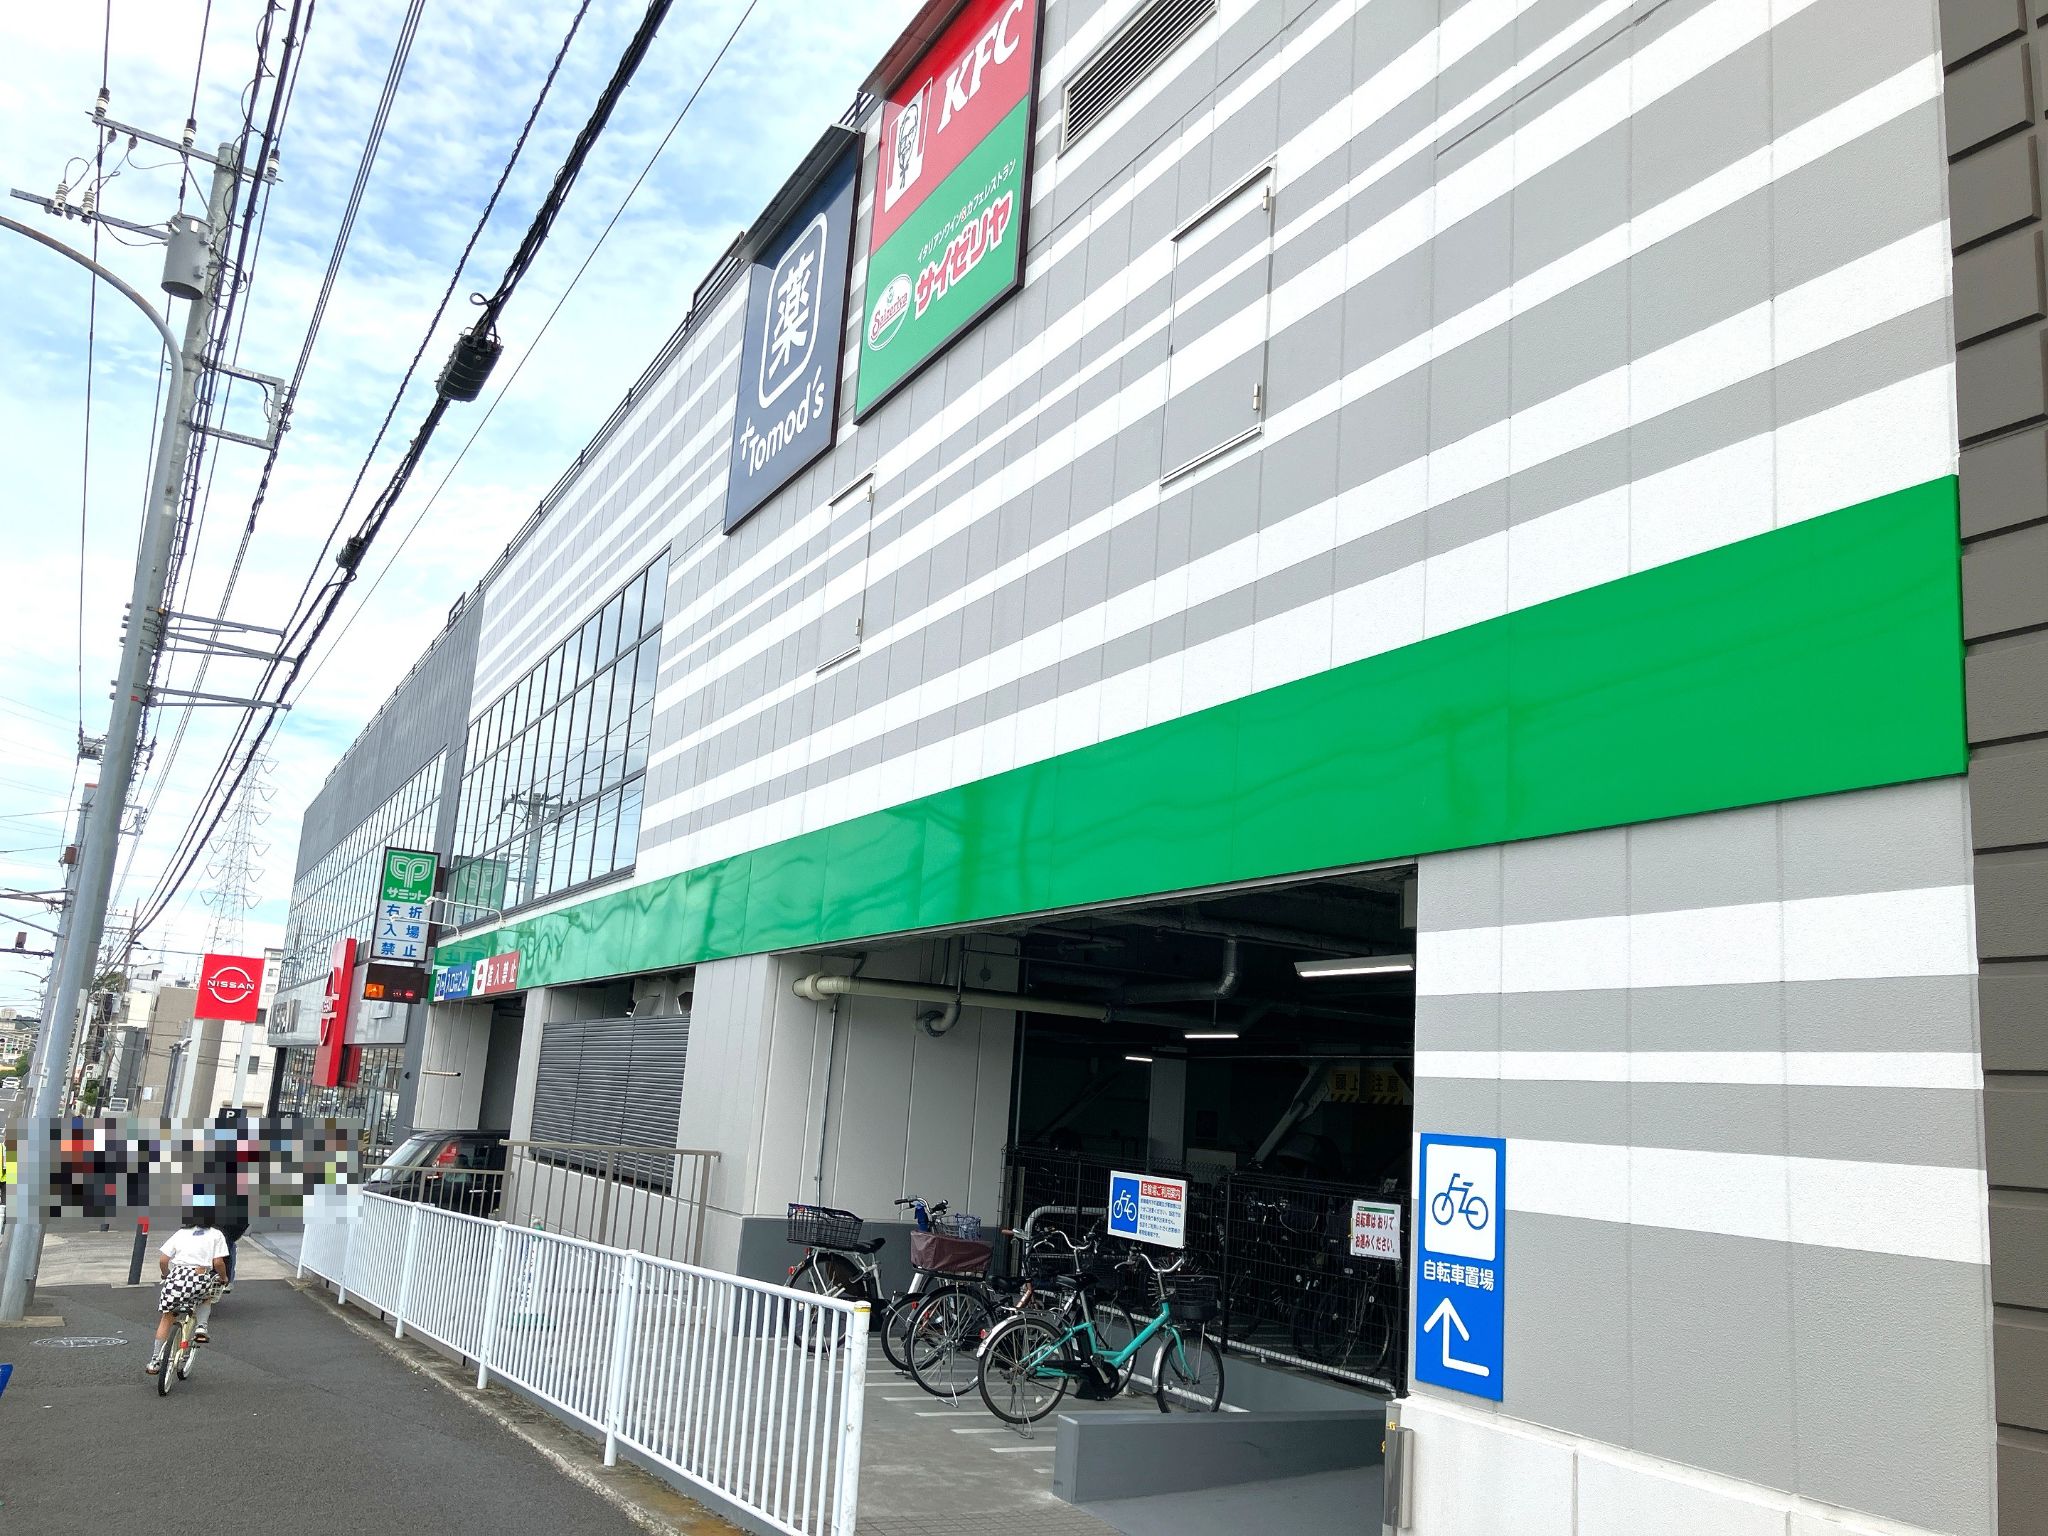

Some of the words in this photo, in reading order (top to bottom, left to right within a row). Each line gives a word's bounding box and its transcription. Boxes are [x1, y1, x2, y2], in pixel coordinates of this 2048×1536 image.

[937, 0, 1024, 134] KFC
[914, 189, 1014, 321] サイゼリヤ
[768, 249, 815, 380] 薬
[749, 365, 825, 477] Tomod's
[386, 886, 428, 901] サミット
[383, 923, 420, 938] 入場
[380, 942, 417, 957] 禁止
[207, 979, 255, 991] NISSAN
[1423, 1259, 1495, 1292] 自転車置場
